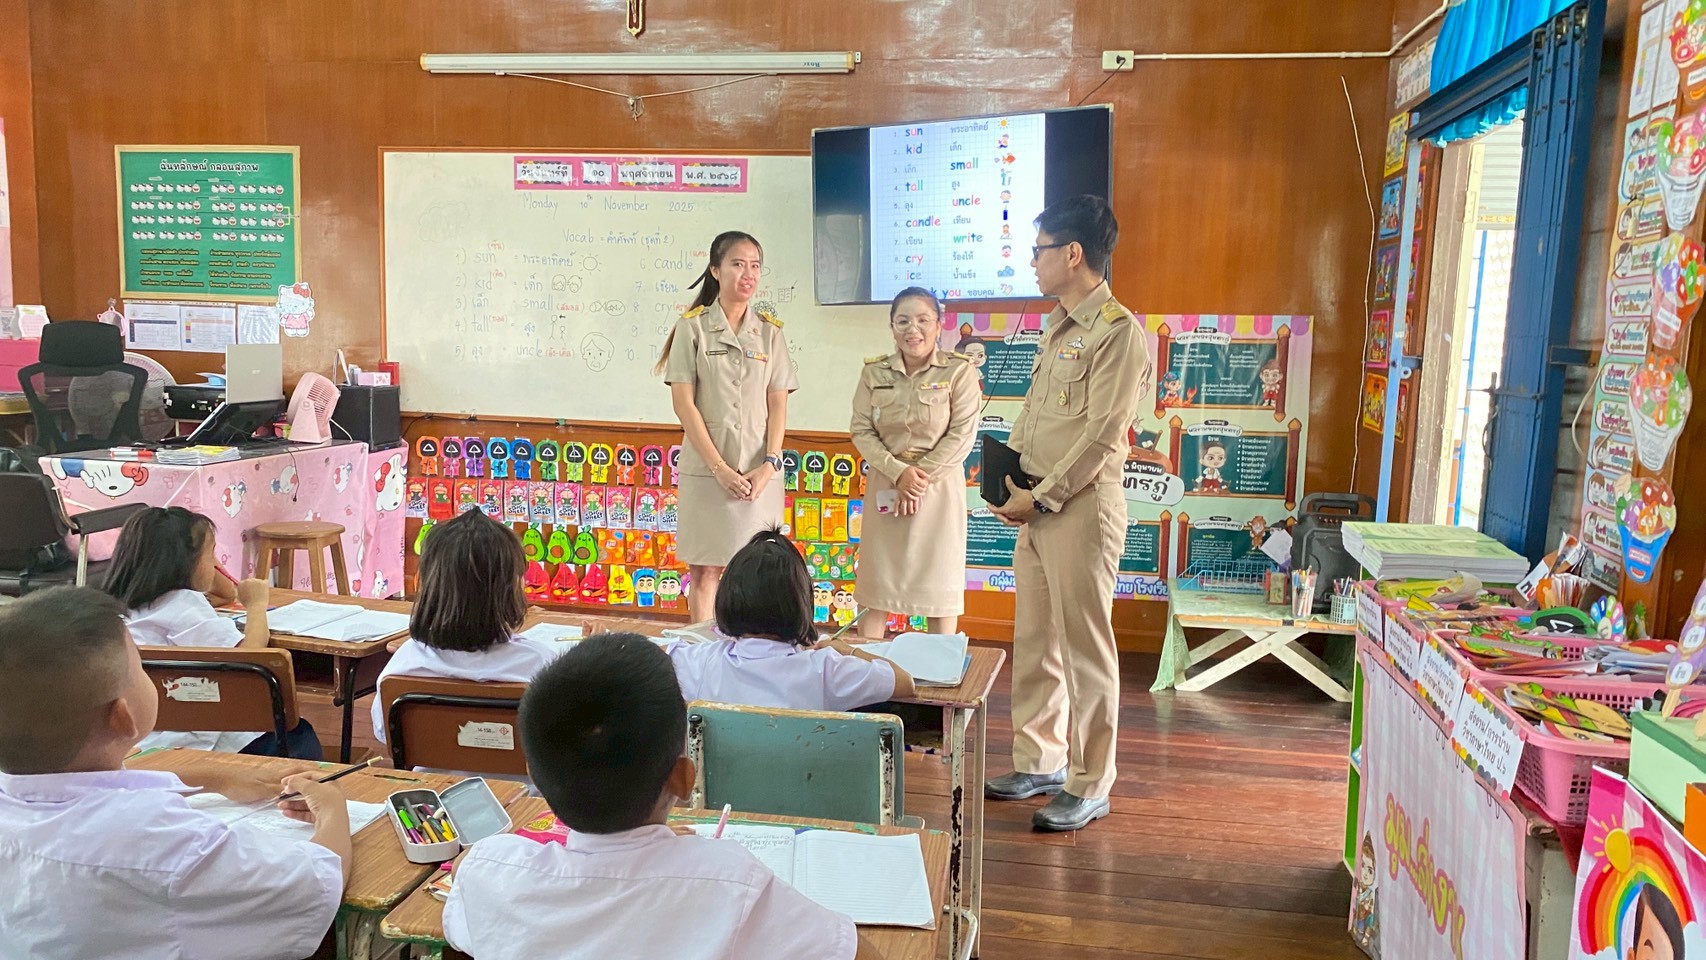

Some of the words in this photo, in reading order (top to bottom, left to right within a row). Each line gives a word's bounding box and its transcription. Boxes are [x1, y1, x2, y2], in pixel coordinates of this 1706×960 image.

[905, 127, 923, 137] sun
[906, 143, 923, 154] kid
[210, 162, 259, 176] กลอนสุภาพ
[950, 157, 979, 171] small
[905, 179, 924, 192] tall
[523, 192, 559, 218] Monday
[605, 196, 649, 211] November
[668, 201, 695, 212] 2025
[952, 194, 981, 207] uncle
[905, 215, 941, 228] candle
[563, 228, 594, 243] Vocab
[953, 232, 983, 244] write
[654, 250, 694, 271] candle
[905, 254, 924, 266] cry
[906, 270, 922, 280] ice
[942, 288, 961, 300] you
[521, 293, 553, 311] small
[654, 302, 673, 325] cry
[516, 339, 543, 357] uncle
[1131, 461, 1162, 473] มิถุนายน
